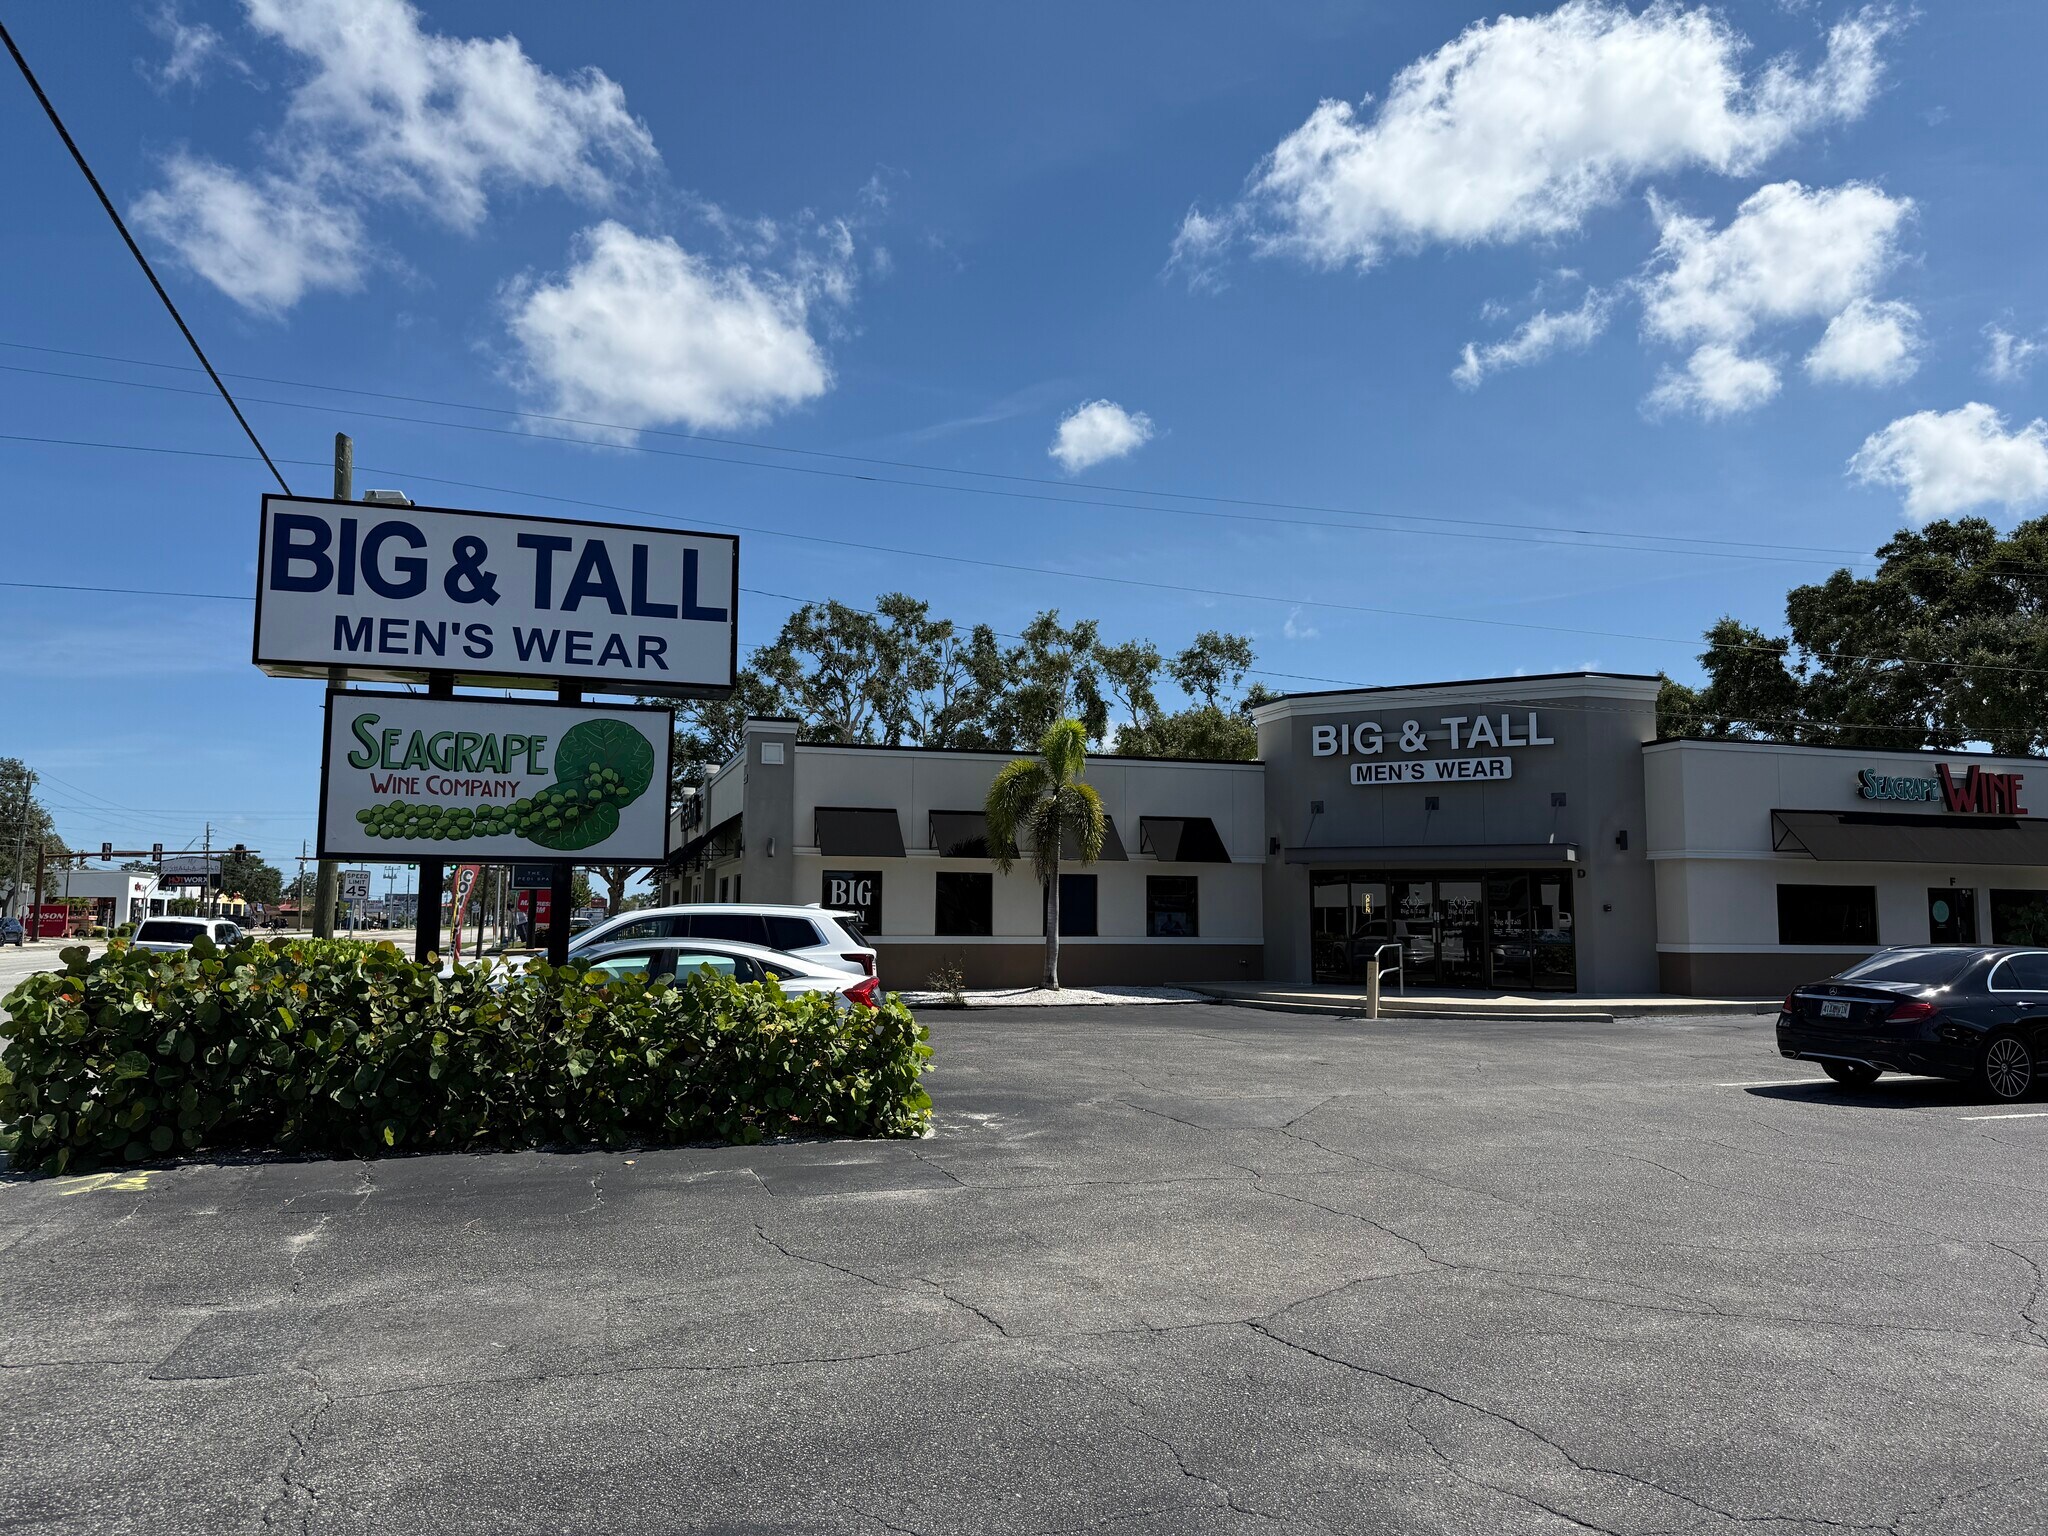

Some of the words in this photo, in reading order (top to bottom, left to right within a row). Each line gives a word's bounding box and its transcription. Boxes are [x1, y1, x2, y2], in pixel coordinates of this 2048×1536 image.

[270, 512, 428, 600] BIG
[443, 535, 501, 606] &
[517, 533, 728, 623] TALL
[333, 615, 494, 660] MEN'S
[513, 627, 670, 670] WEAR
[347, 713, 548, 775] SEAGRAPE
[1312, 722, 1383, 757] BIG
[1399, 719, 1428, 753] &
[1440, 712, 1555, 751] TALL
[1356, 763, 1425, 782] MEN'S
[1436, 759, 1505, 779] WEAR
[370, 772, 420, 795] WINE
[426, 776, 521, 799] COMPANY
[1857, 768, 1940, 802] SEAGRAPE
[1935, 763, 2029, 815] WINE
[1577, 868, 1586, 879] D
[1949, 877, 1956, 886] F
[346, 886, 367, 897] 45
[830, 879, 872, 906] BIG
